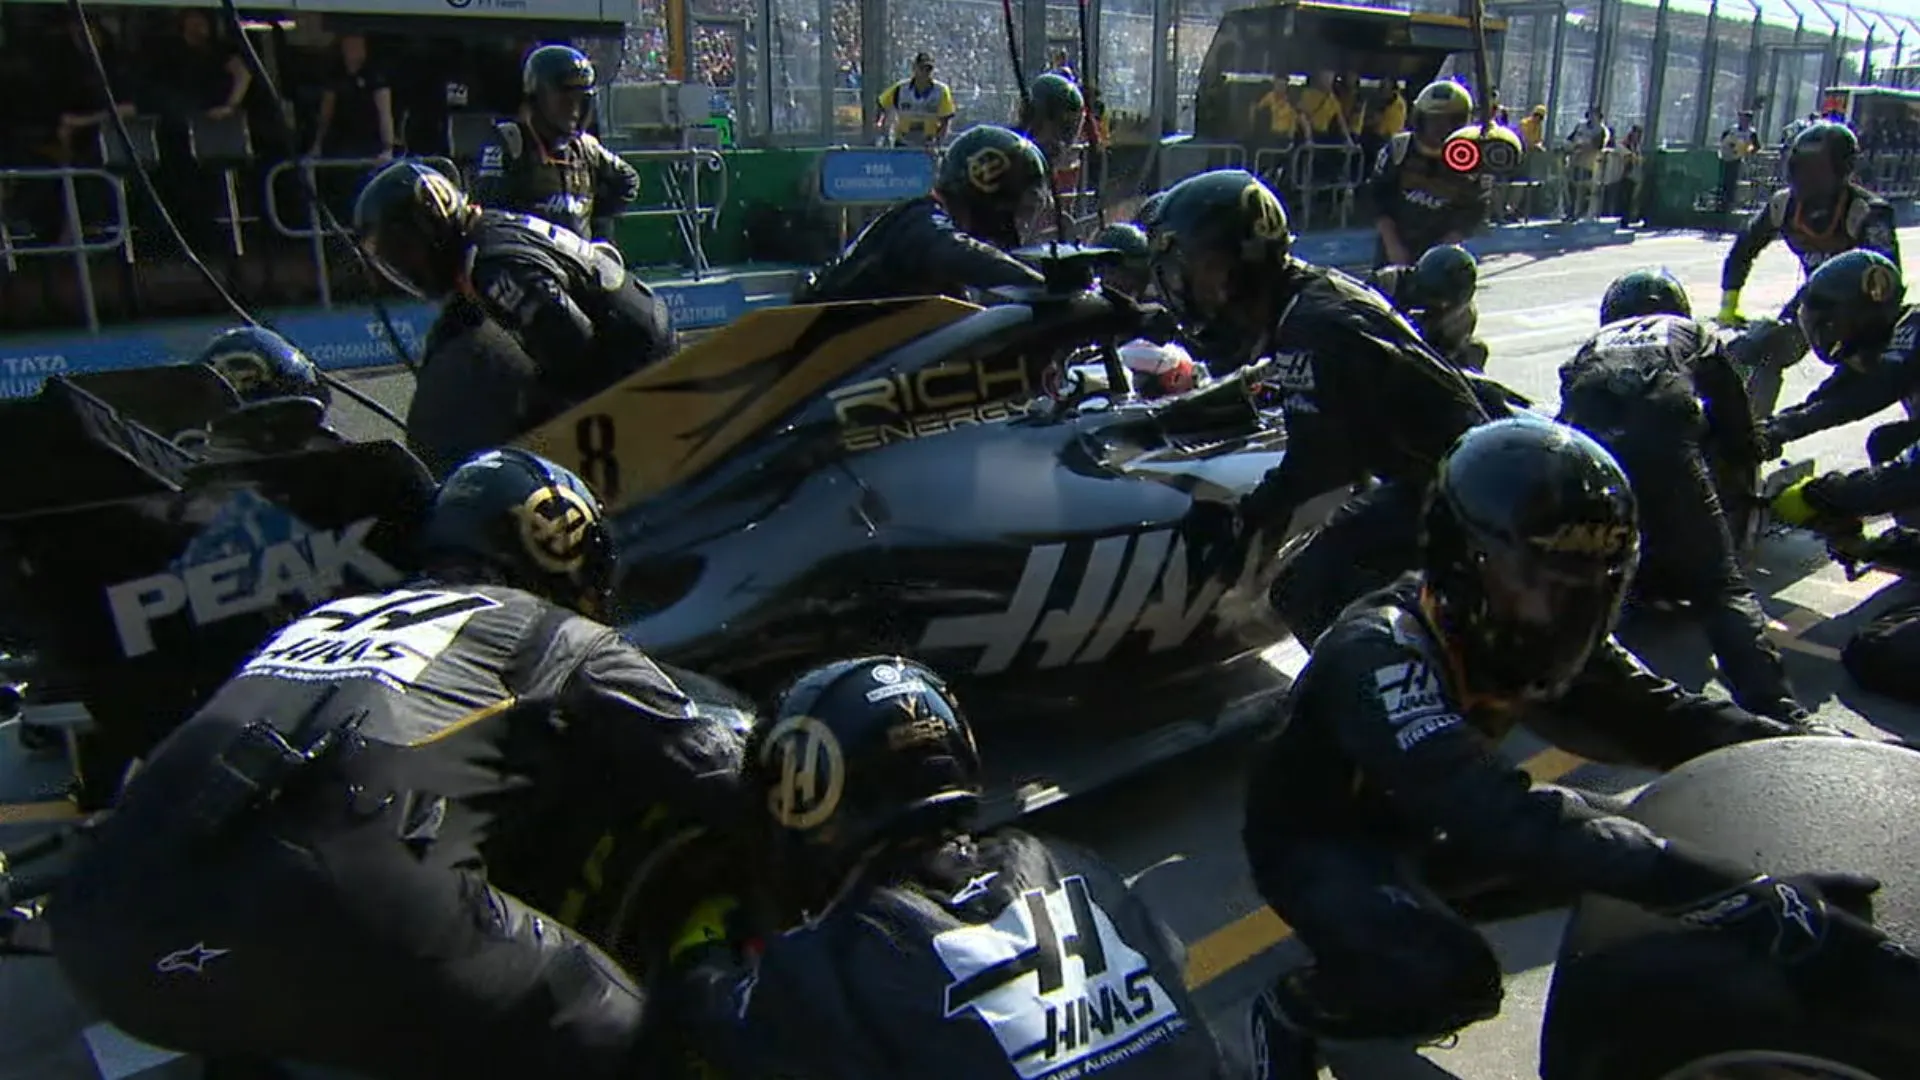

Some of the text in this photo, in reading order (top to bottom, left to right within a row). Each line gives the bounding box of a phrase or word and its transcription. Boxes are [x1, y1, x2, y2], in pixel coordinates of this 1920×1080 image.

[3, 355, 68, 375] TATA
[827, 355, 1031, 424] RICH
[576, 413, 619, 497] 8
[843, 399, 1036, 451] ENERGY
[106, 517, 404, 658] PEAK
[268, 637, 406, 664] HAAS
[1011, 967, 1154, 1062] HAAS
